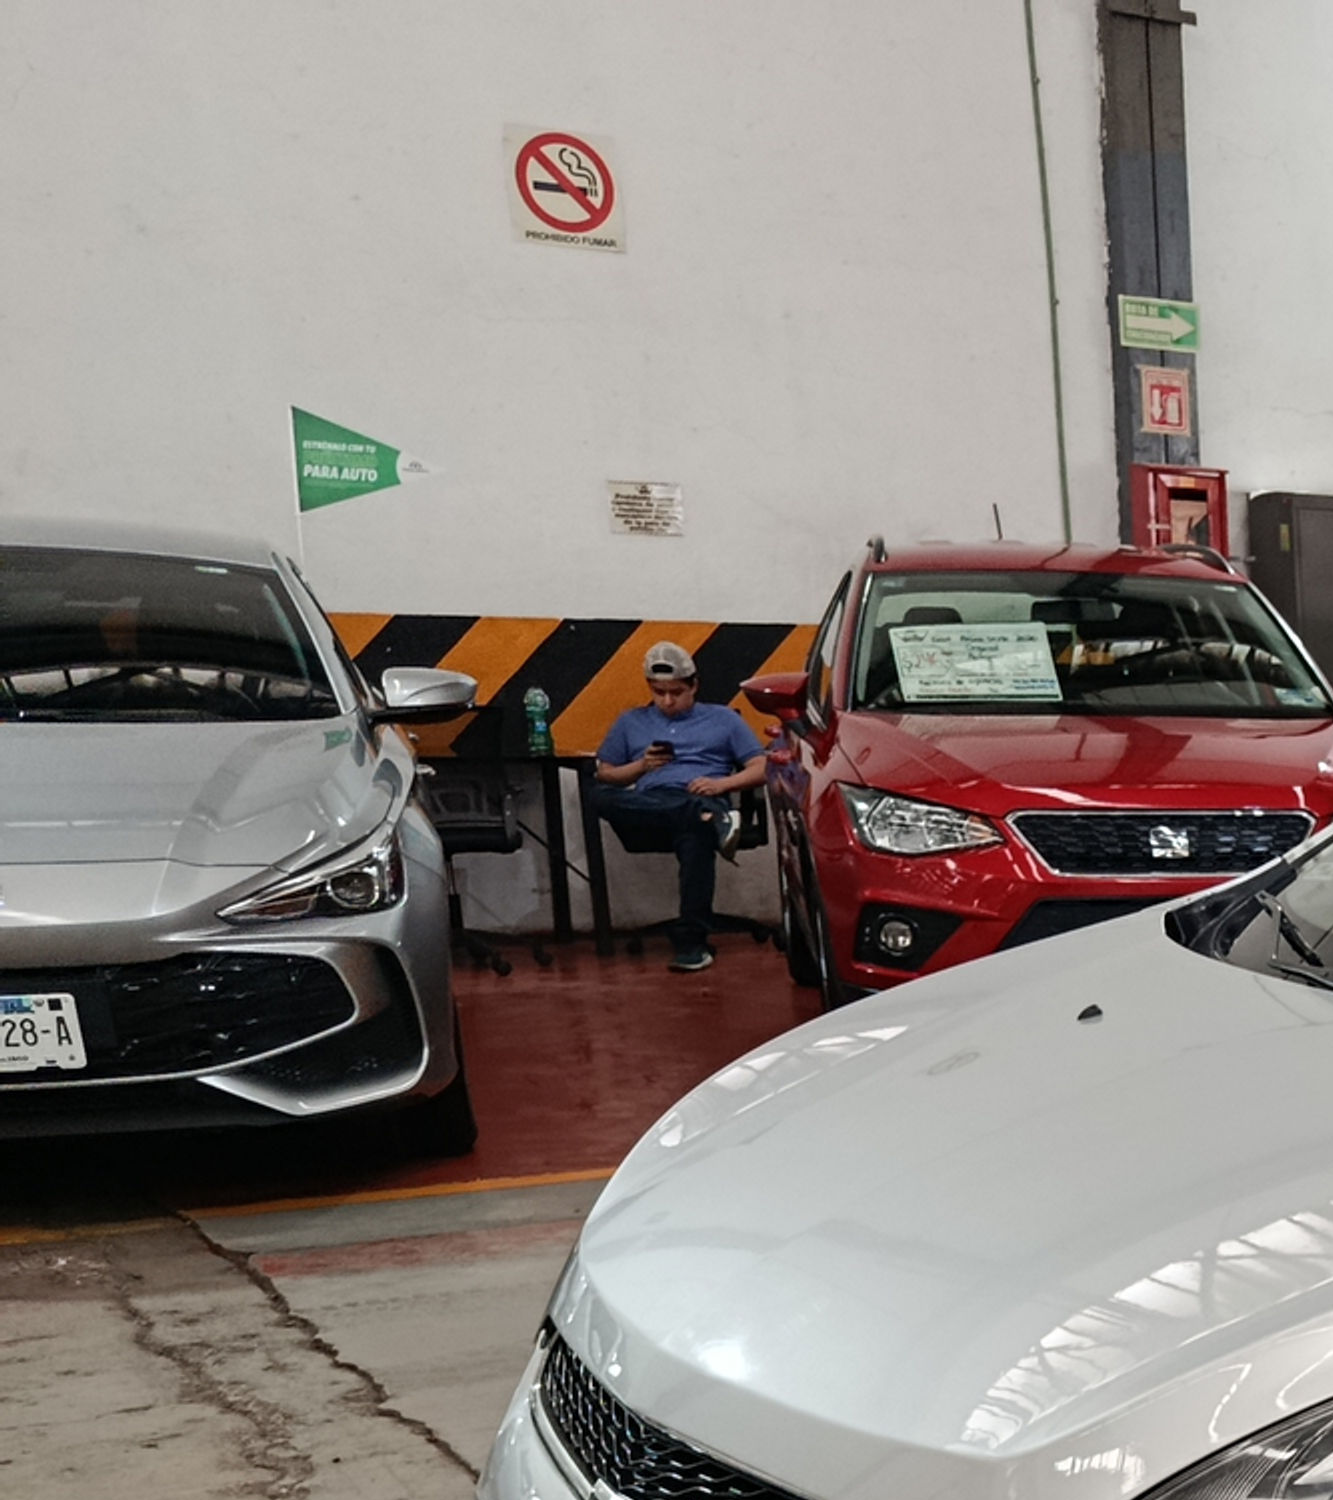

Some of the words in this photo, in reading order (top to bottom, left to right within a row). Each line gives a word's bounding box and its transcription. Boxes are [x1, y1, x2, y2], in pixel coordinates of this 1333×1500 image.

[525, 230, 580, 245] PROHIBIDO
[582, 236, 617, 248] FUMAR
[303, 464, 339, 479] PARA
[340, 467, 378, 482] AUTO
[0, 1015, 73, 1048] 28-A
